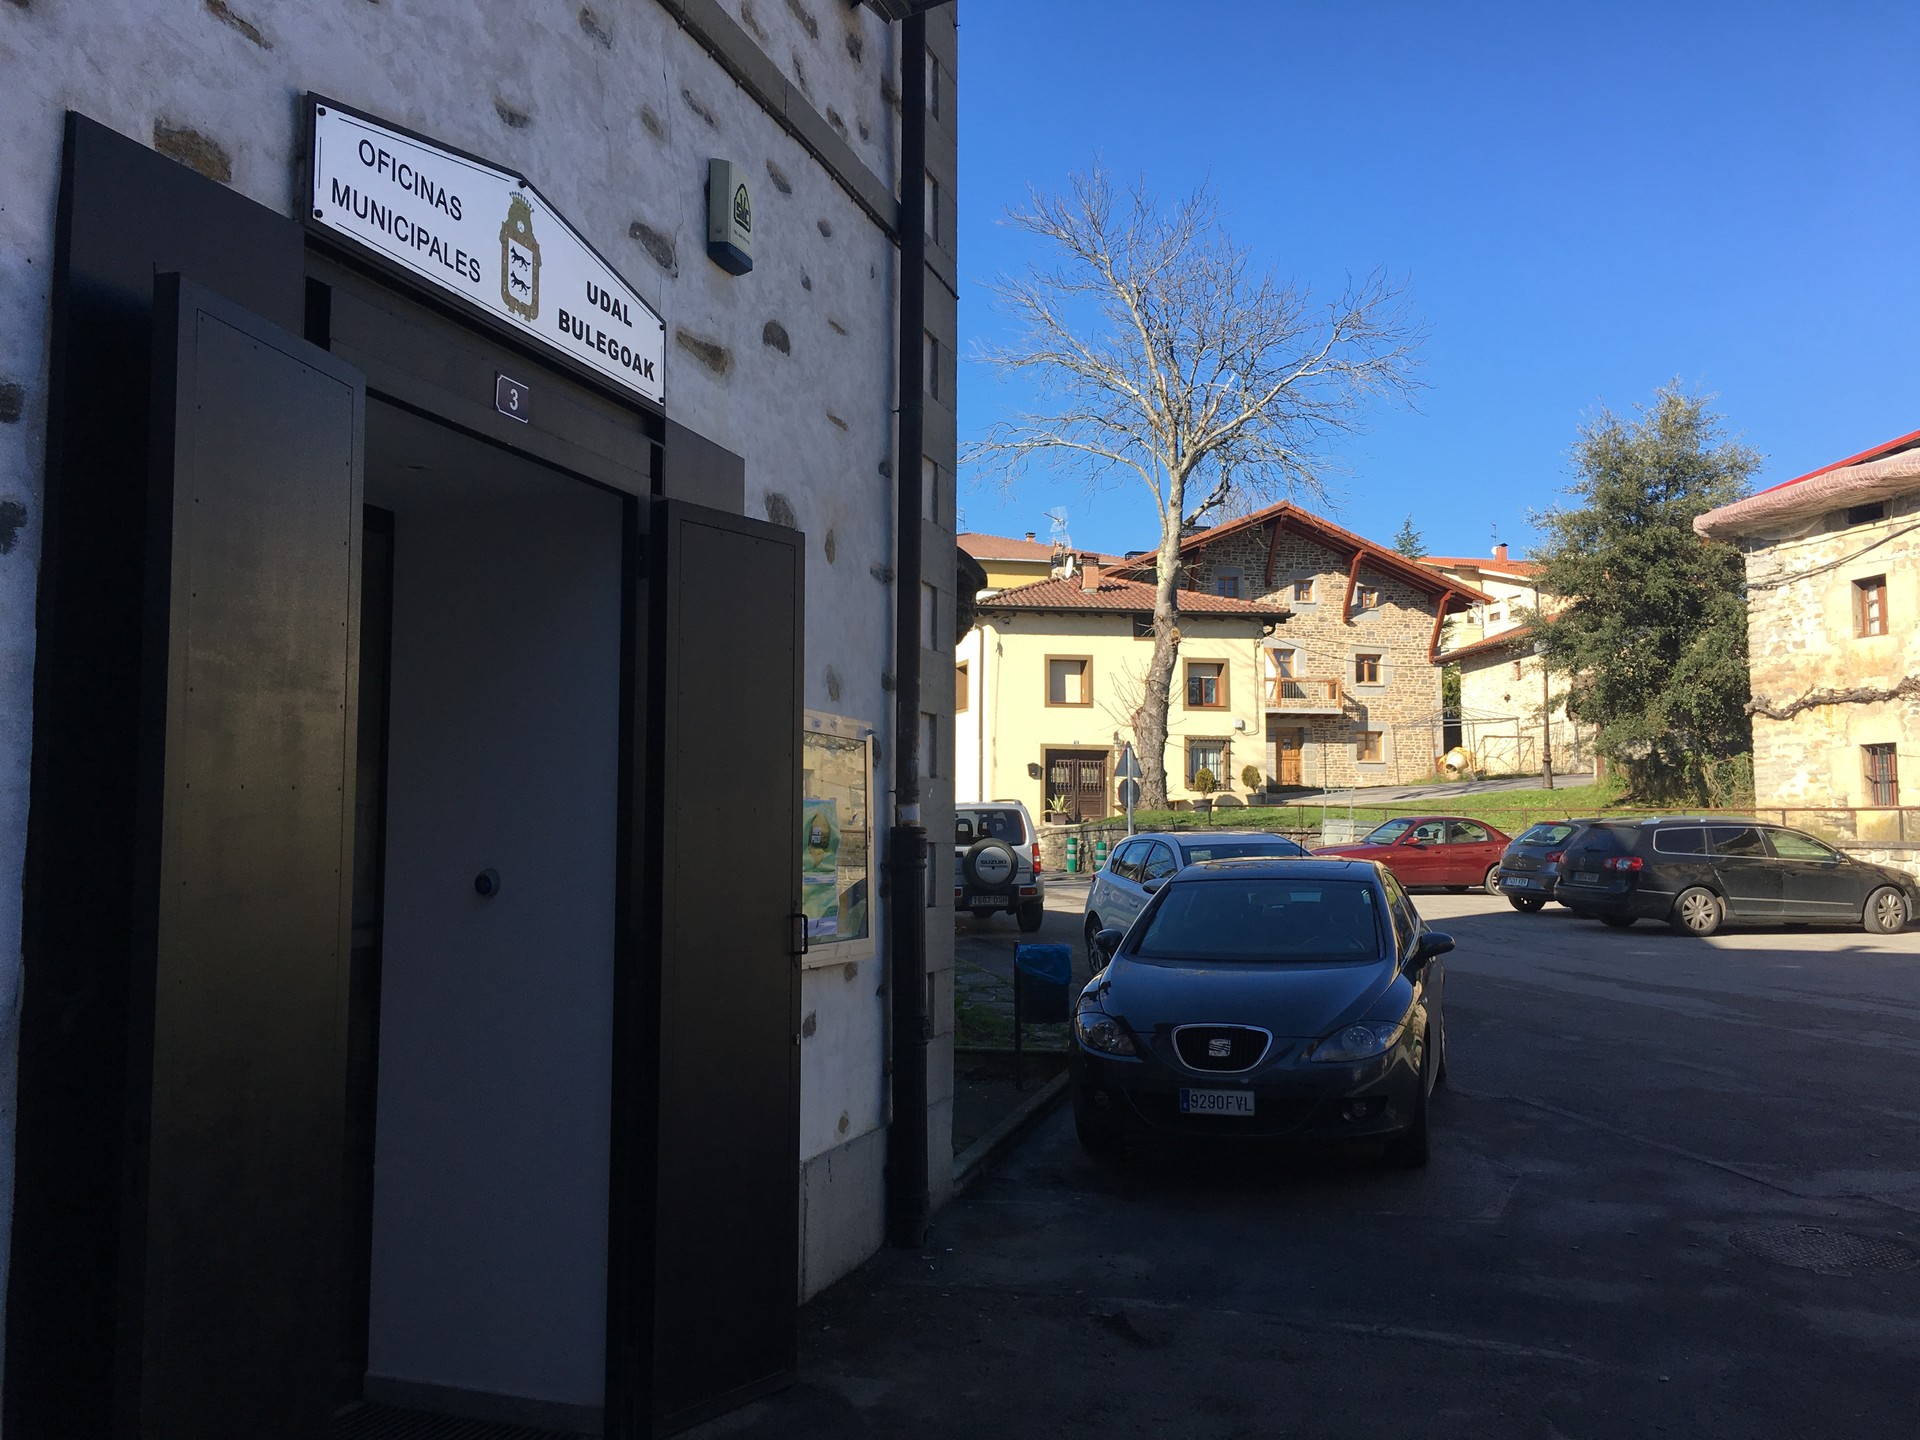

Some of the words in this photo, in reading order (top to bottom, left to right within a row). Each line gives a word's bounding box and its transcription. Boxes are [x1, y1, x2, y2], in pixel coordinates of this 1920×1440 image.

[358, 139, 463, 222] OFICINAS
[332, 178, 481, 283] MUNICIPALES
[586, 280, 633, 328] UDAL
[558, 308, 655, 383] BULEGOAK
[509, 388, 519, 411] 3
